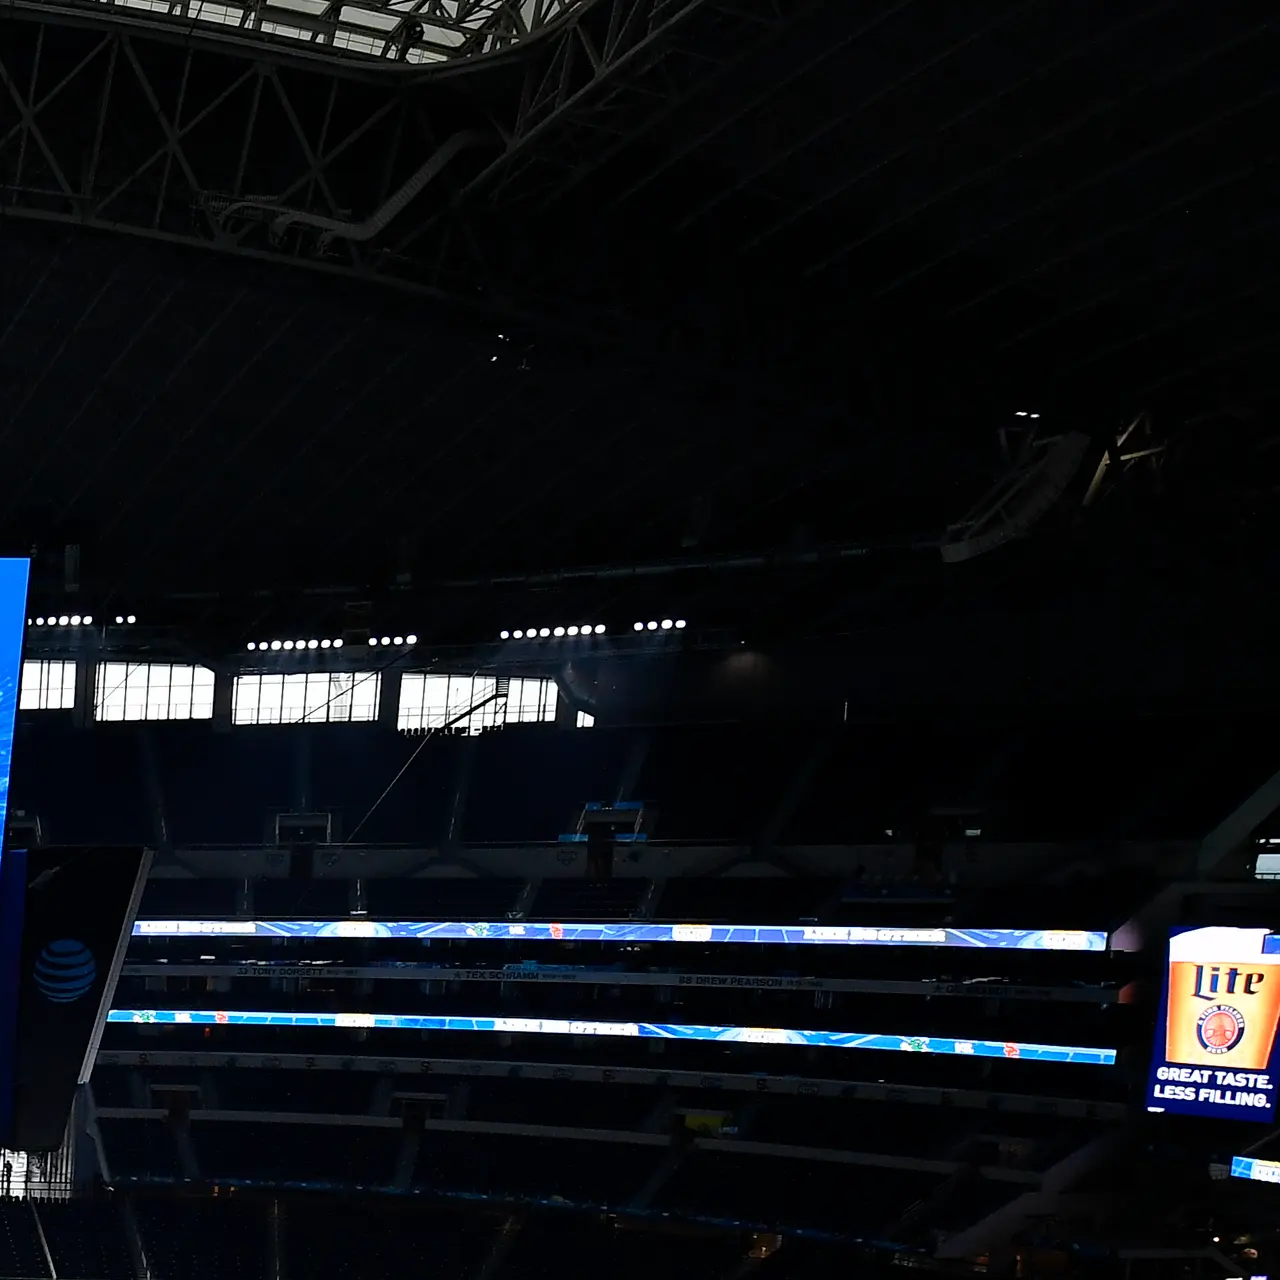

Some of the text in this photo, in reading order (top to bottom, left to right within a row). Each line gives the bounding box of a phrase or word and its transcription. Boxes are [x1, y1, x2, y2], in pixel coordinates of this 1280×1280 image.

[251, 967, 277, 975] TONY
[279, 967, 323, 976] DORSETT
[466, 970, 485, 979] TEX
[489, 971, 539, 980] SCHRAMM
[696, 976, 728, 985] DREW
[730, 977, 783, 987] PEARSON
[1190, 964, 1265, 1001] Lite
[1156, 1066, 1274, 1089] GREAT TASTE.
[1153, 1084, 1272, 1108] LESS FILLING.
